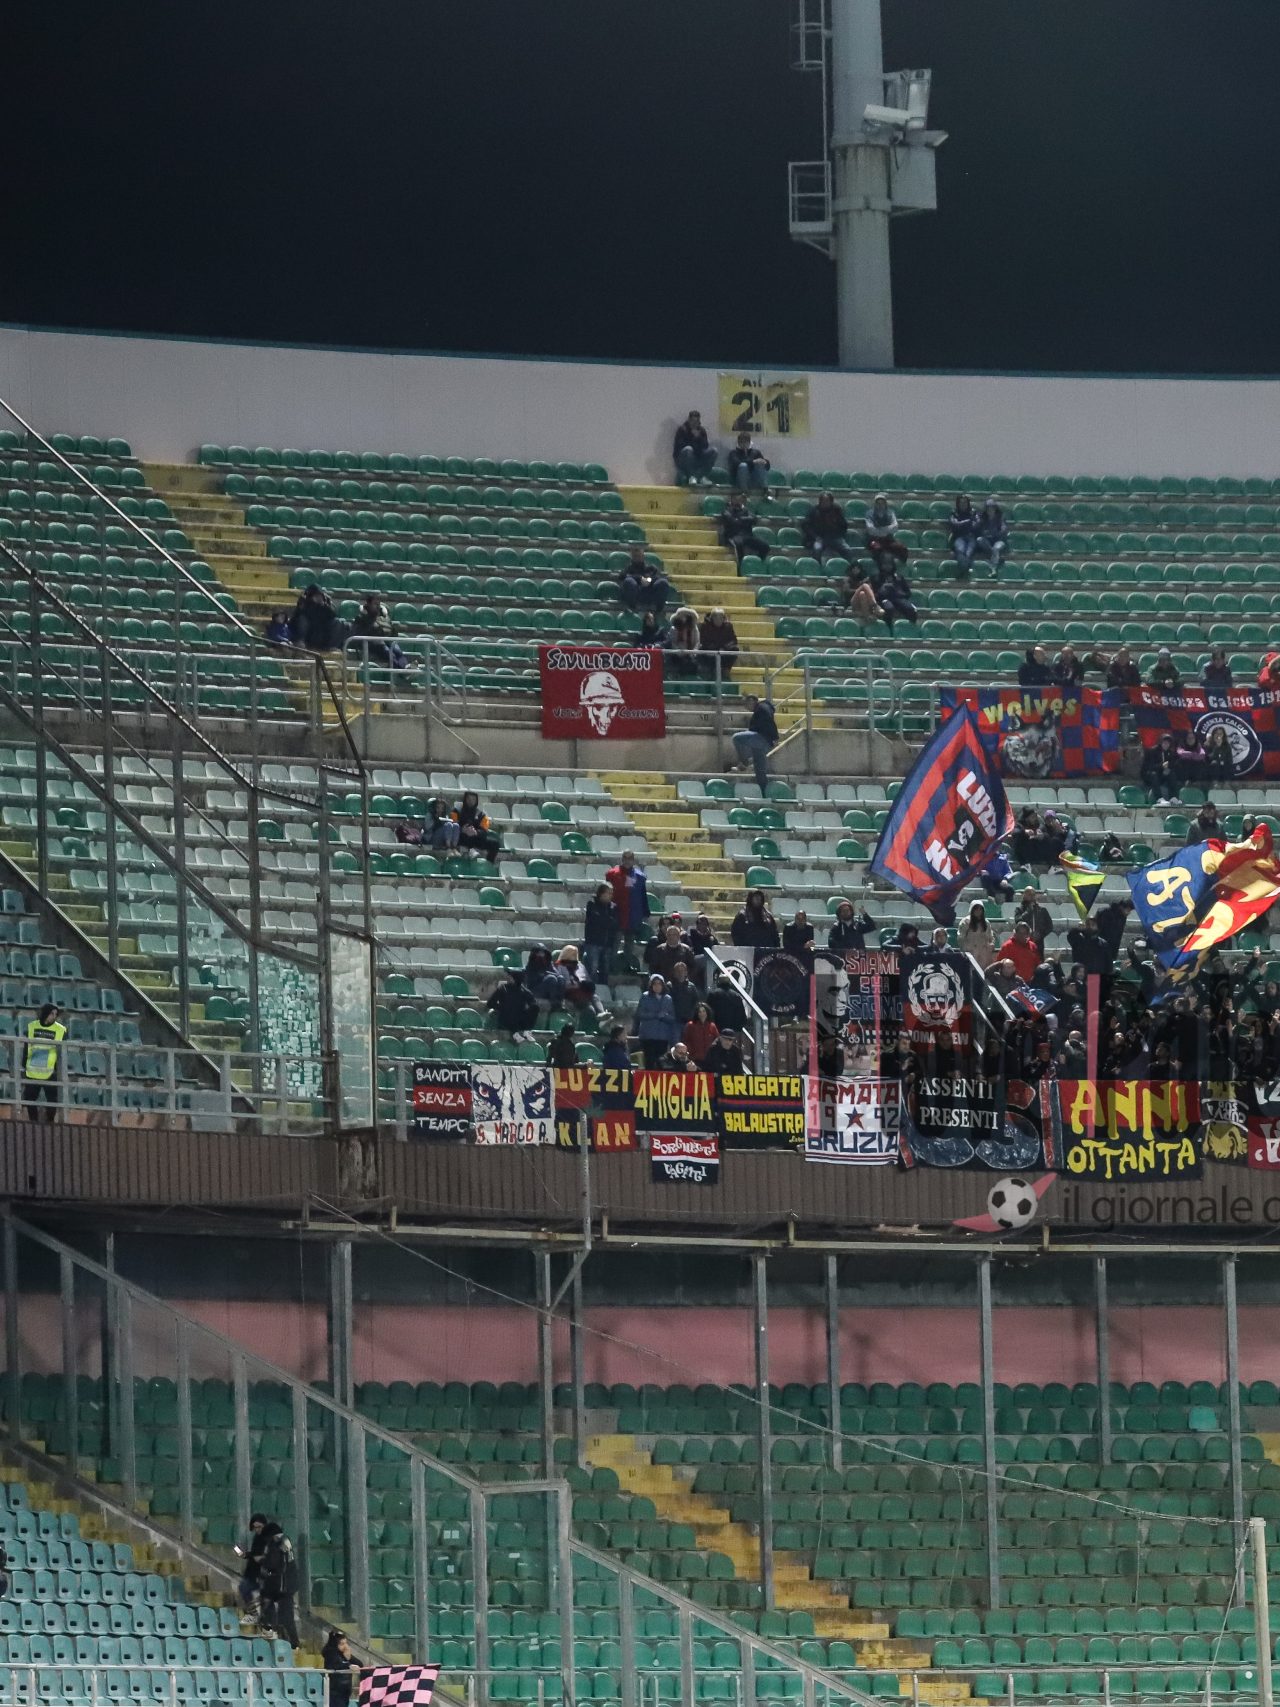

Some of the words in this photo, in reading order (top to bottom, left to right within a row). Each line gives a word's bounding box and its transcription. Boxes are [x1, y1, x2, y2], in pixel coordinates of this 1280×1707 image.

[731, 391, 790, 433] 21
[554, 1068, 629, 1092] LUZZI
[722, 1075, 801, 1097] BRIGATA
[807, 1080, 899, 1104] ARMATA
[919, 1077, 994, 1100] ASSENTI
[418, 1091, 466, 1107] SENZA
[1070, 1080, 1188, 1140] ANNI
[724, 1112, 804, 1134] BALAUSTRA
[919, 1106, 999, 1130] PRESENTI
[558, 1122, 631, 1146] KLAN
[807, 1129, 898, 1153] BRUZIA
[1067, 1138, 1196, 1179] OTTANTA
